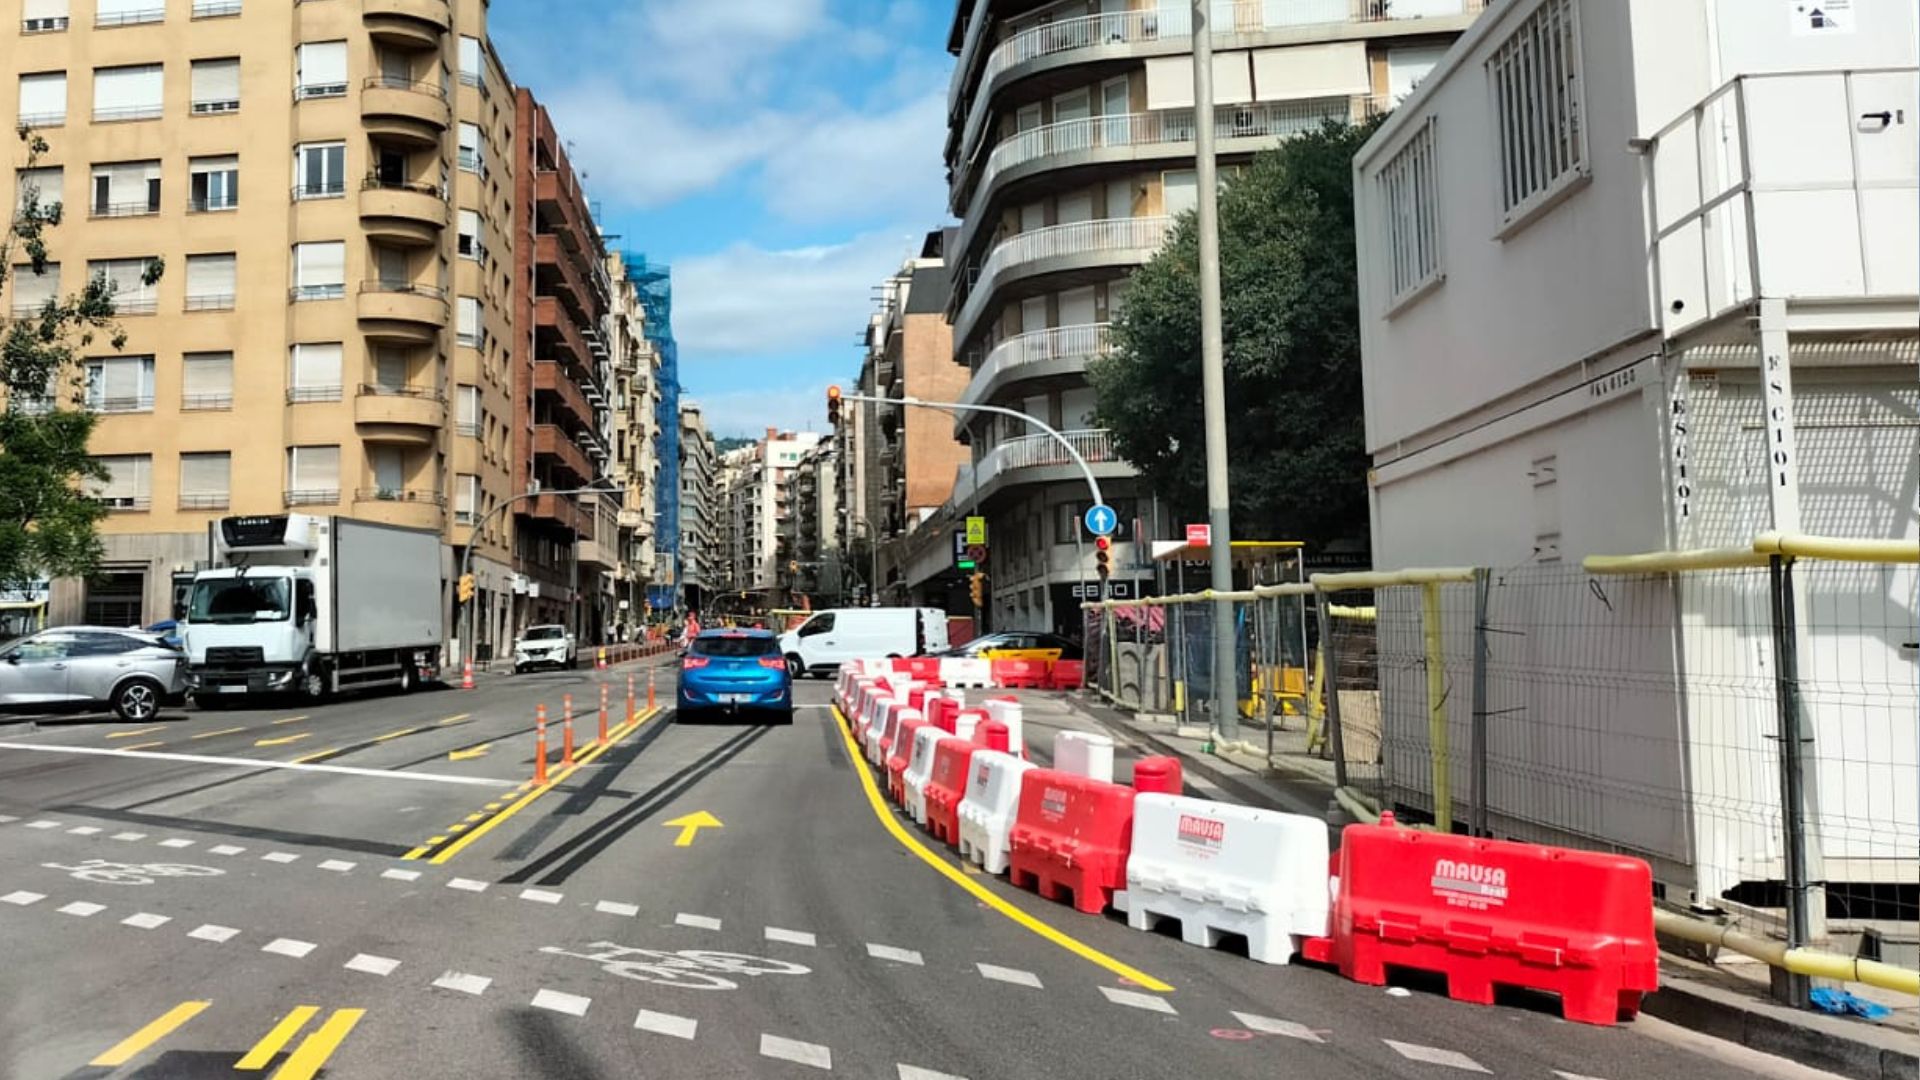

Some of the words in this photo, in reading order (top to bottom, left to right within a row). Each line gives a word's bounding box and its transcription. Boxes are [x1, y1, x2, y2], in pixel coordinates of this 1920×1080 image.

[1672, 399, 1690, 516] ESC101
[1180, 816, 1222, 840] MAUSA
[1435, 859, 1506, 887] MAUSA
